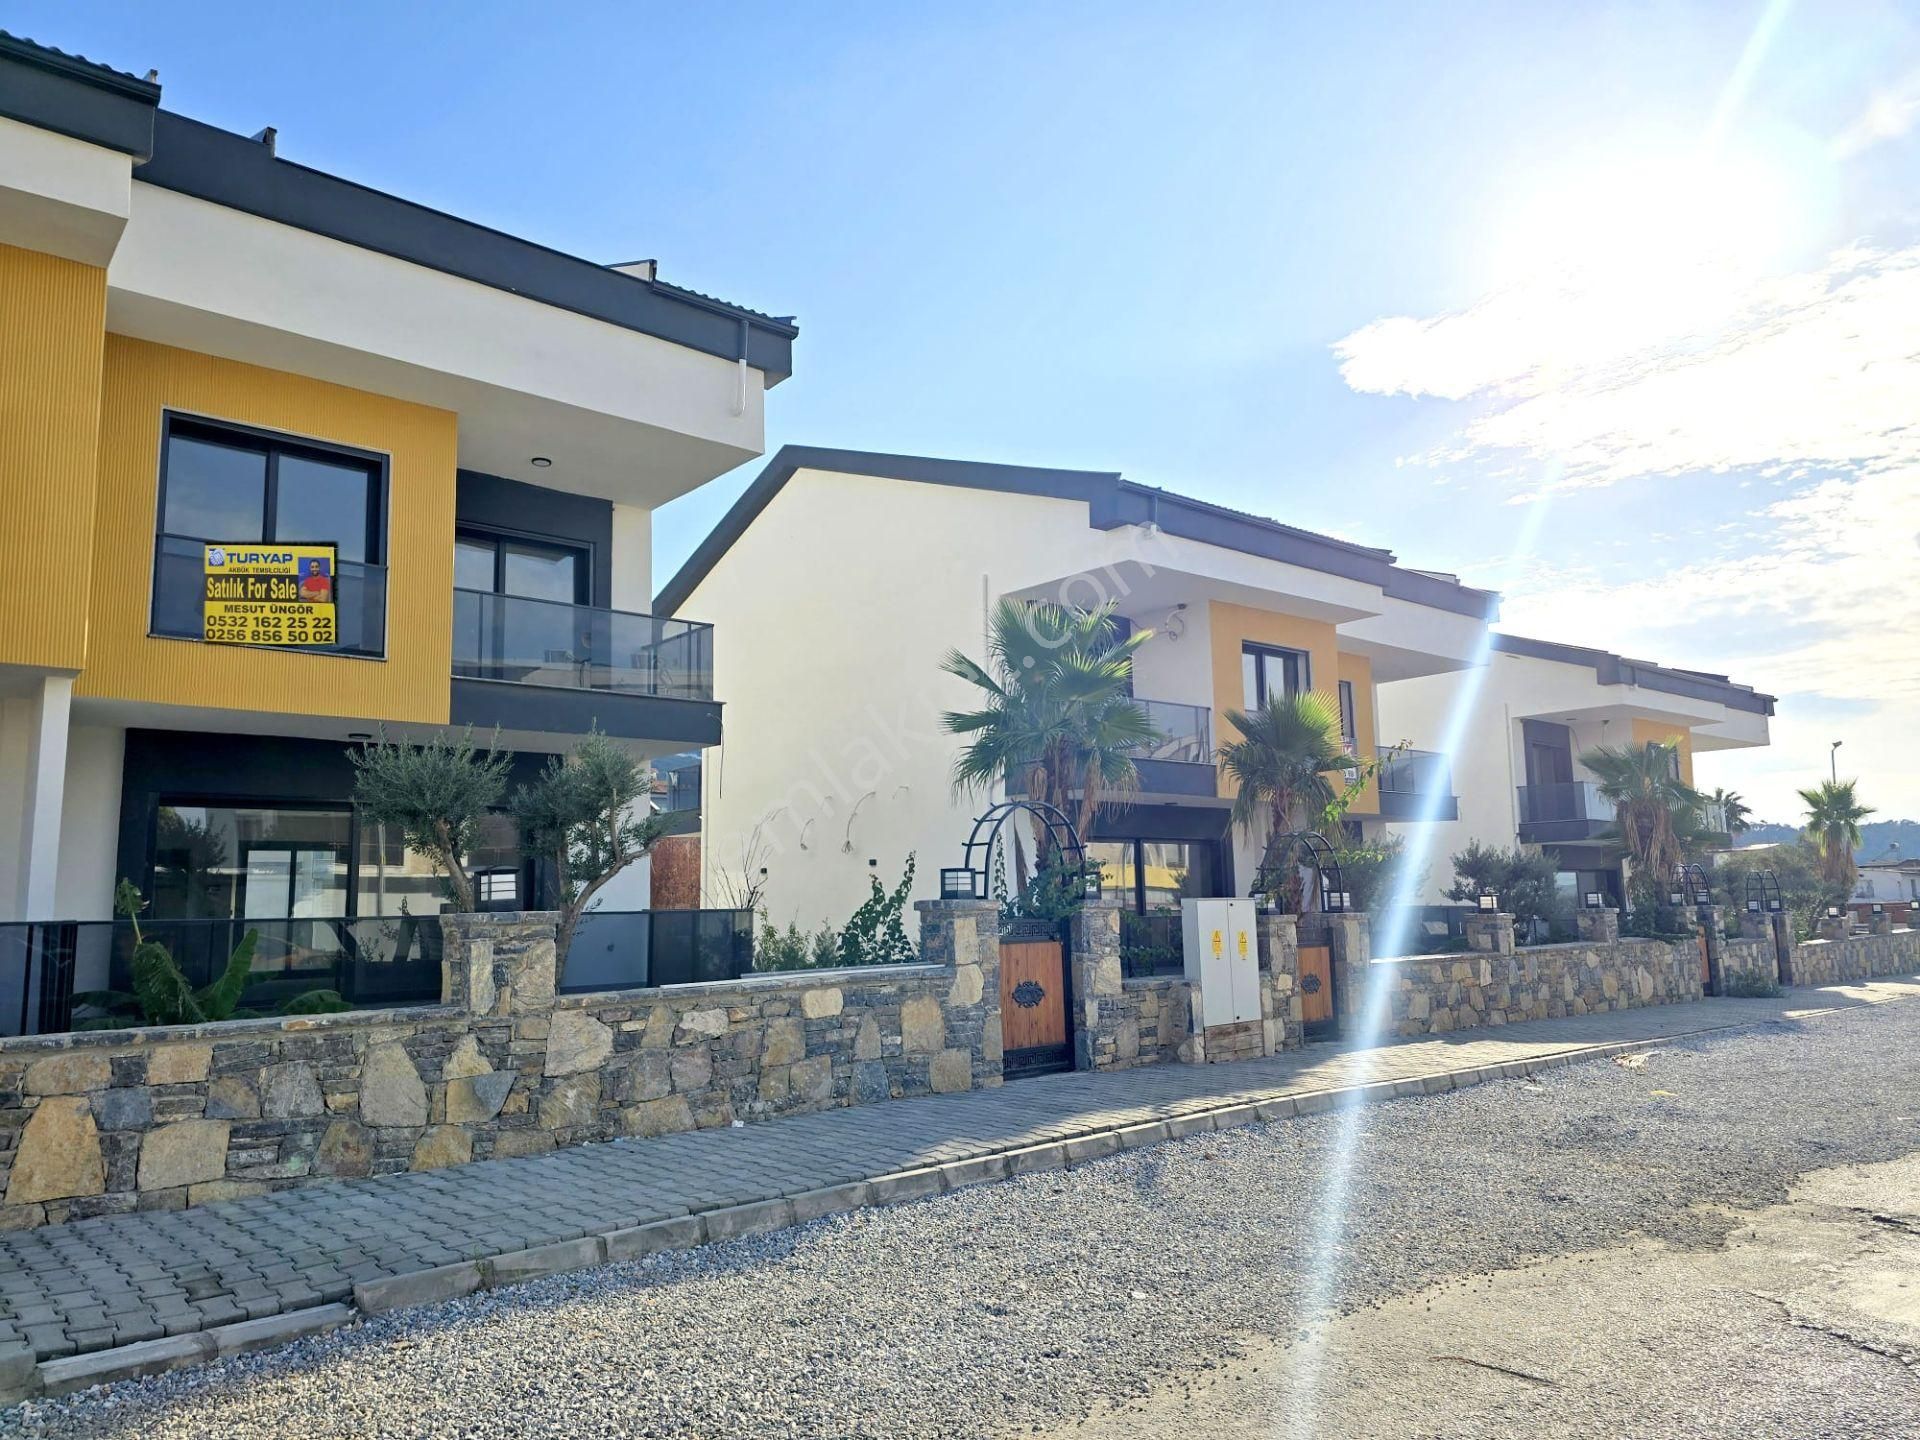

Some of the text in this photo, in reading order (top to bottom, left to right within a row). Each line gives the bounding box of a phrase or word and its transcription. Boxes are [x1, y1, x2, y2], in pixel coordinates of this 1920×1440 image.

[227, 553, 293, 564] TURYAP
[207, 577, 297, 600] Satılık For Sale
[224, 603, 313, 614] MESUT ÜNGÖR
[207, 615, 331, 629] 0532 162 25 22
[206, 629, 332, 642] 0256 856 50 02
